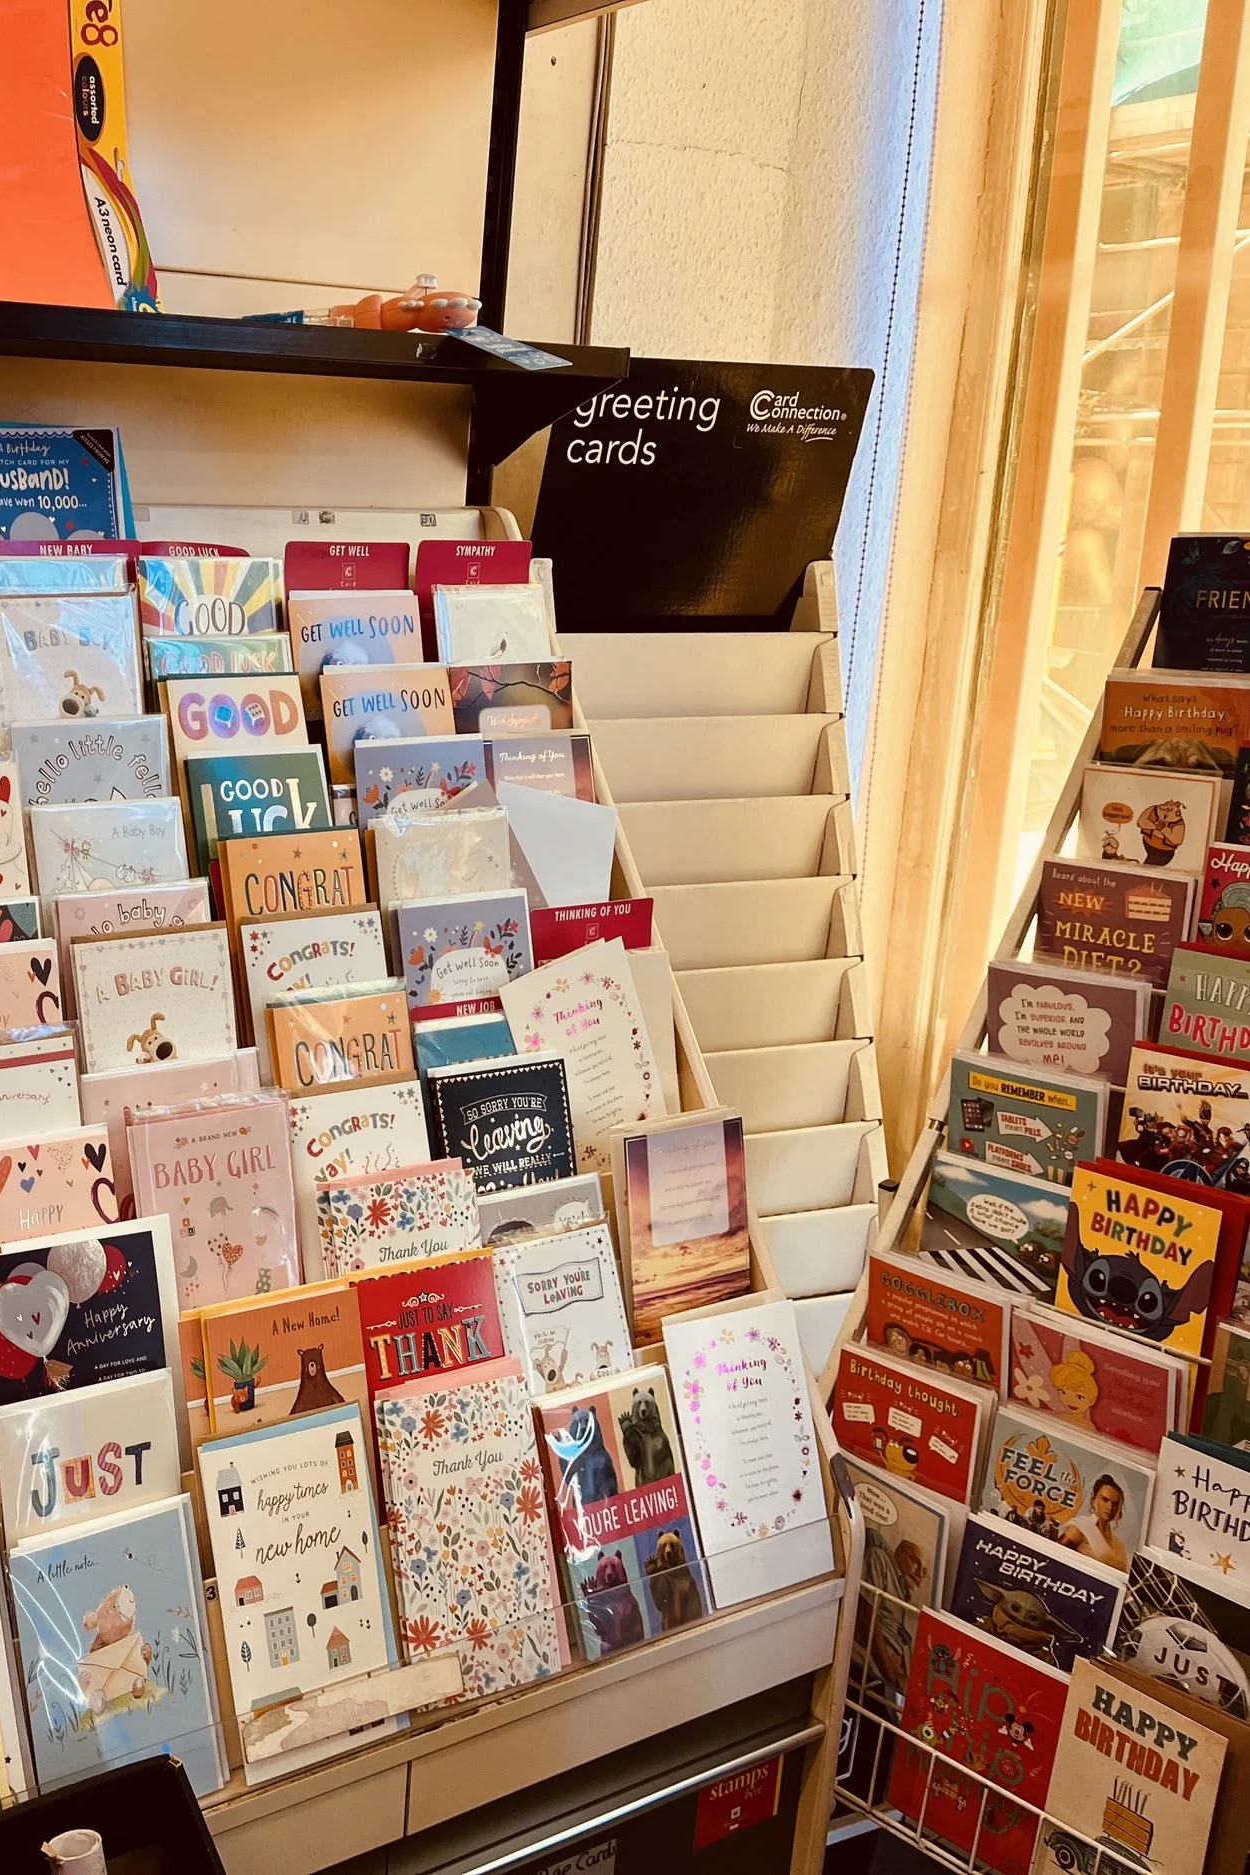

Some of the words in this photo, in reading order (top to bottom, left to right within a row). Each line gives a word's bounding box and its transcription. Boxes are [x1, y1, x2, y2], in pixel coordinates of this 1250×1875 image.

[81, 75, 89, 117] colours
[89, 75, 100, 124] assorted
[94, 196, 109, 218] A3
[101, 219, 117, 252] neon
[112, 252, 128, 287] card
[566, 429, 656, 466] cards
[746, 422, 760, 433] We
[763, 422, 786, 434] Make
[786, 423, 794, 433] A
[796, 424, 837, 441] Difference
[58, 458, 70, 466] MY
[39, 544, 63, 556] NEW
[66, 543, 94, 556] BABY
[168, 545, 195, 557] GOOD
[197, 546, 221, 558] LUCK
[329, 543, 347, 557] GET
[348, 543, 370, 557] WELL
[455, 544, 496, 558] SYMPATHY
[177, 689, 299, 741] GOOD
[333, 698, 354, 717] GET
[361, 694, 396, 714] WELL
[399, 687, 447, 713] SOON
[1124, 707, 1164, 721] Happy
[1167, 706, 1226, 722] Birthday
[220, 778, 284, 801] GOOD
[244, 866, 354, 916] CONGRAT
[1058, 892, 1105, 912] NEW
[554, 905, 597, 923] THINKING
[599, 903, 611, 918] OF
[612, 902, 631, 916] YOU
[1054, 920, 1156, 953] MIRACLE
[456, 1003, 473, 1017] NEW
[475, 1001, 496, 1015] JOB
[465, 1107, 479, 1121] SO
[479, 1098, 509, 1117] SORRY
[510, 1095, 544, 1110] YOU'RE
[999, 1113, 1027, 1126] TABLETS
[153, 1151, 218, 1190] BABY
[226, 1144, 277, 1180] GIRL
[986, 1143, 1025, 1162] PLATFORMS
[1105, 1188, 1193, 1239] HAPPY
[378, 1243, 420, 1263] Thank
[421, 1239, 451, 1259] You
[1090, 1211, 1193, 1267] BIRTHDAY
[83, 1301, 129, 1328] Happy
[879, 1271, 987, 1323] GOGGLEBOX
[66, 1313, 156, 1357] Anniversary
[368, 1315, 492, 1381] THANK
[849, 1358, 904, 1398] Birthday
[31, 1441, 152, 1518] JUST
[432, 1456, 473, 1478] Thank
[473, 1448, 504, 1473] You
[999, 1446, 1059, 1484] FEEL
[256, 1488, 295, 1521] happy
[295, 1480, 330, 1503] times
[624, 1486, 680, 1525] LEAVING!
[1003, 1475, 1078, 1509] FORCE
[255, 1538, 292, 1565] new
[294, 1522, 342, 1556] home
[976, 1537, 1047, 1572] HAPPY
[998, 1561, 1105, 1607] BIRTHDAY
[1153, 1646, 1233, 1695] JUST
[1090, 1683, 1200, 1763] HAPPY
[1073, 1706, 1201, 1803] BIRTHDAY
[709, 1763, 770, 1801] stamps
[743, 1785, 762, 1801] here
